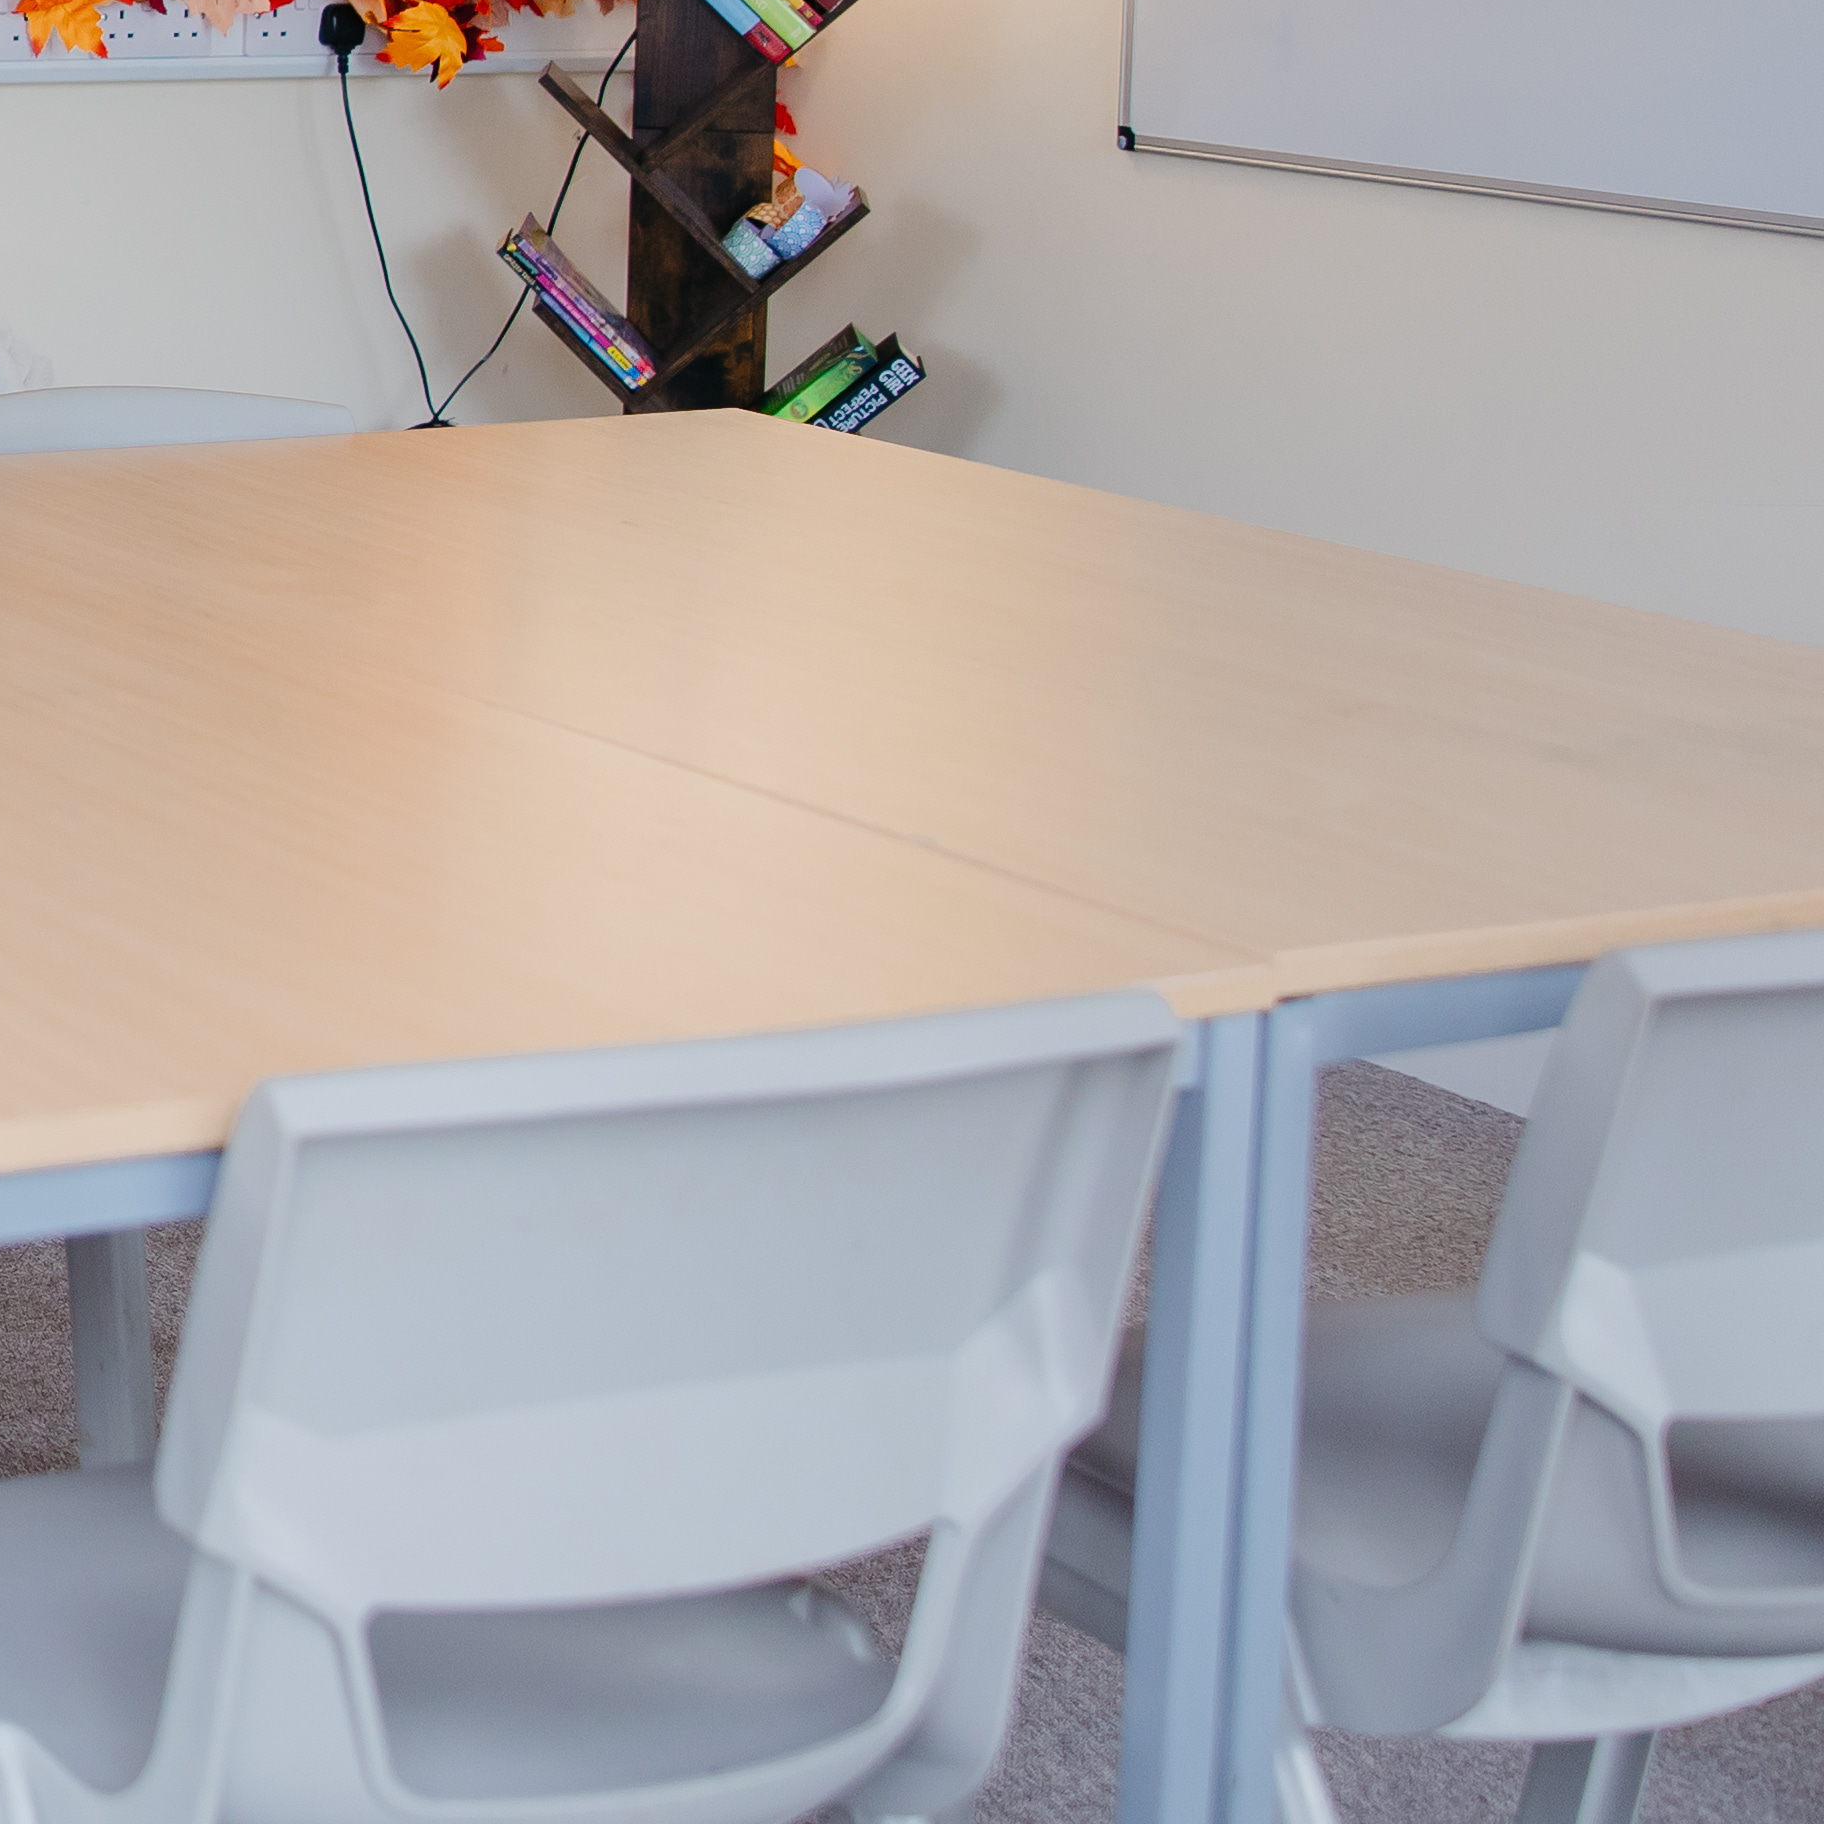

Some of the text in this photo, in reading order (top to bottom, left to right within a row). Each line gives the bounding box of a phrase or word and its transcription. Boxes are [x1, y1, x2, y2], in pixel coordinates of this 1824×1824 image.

[878, 370, 905, 396] GIRL
[891, 359, 920, 386] GEEK
[829, 383, 879, 426] PERFECT
[837, 393, 888, 433] PICTURE
